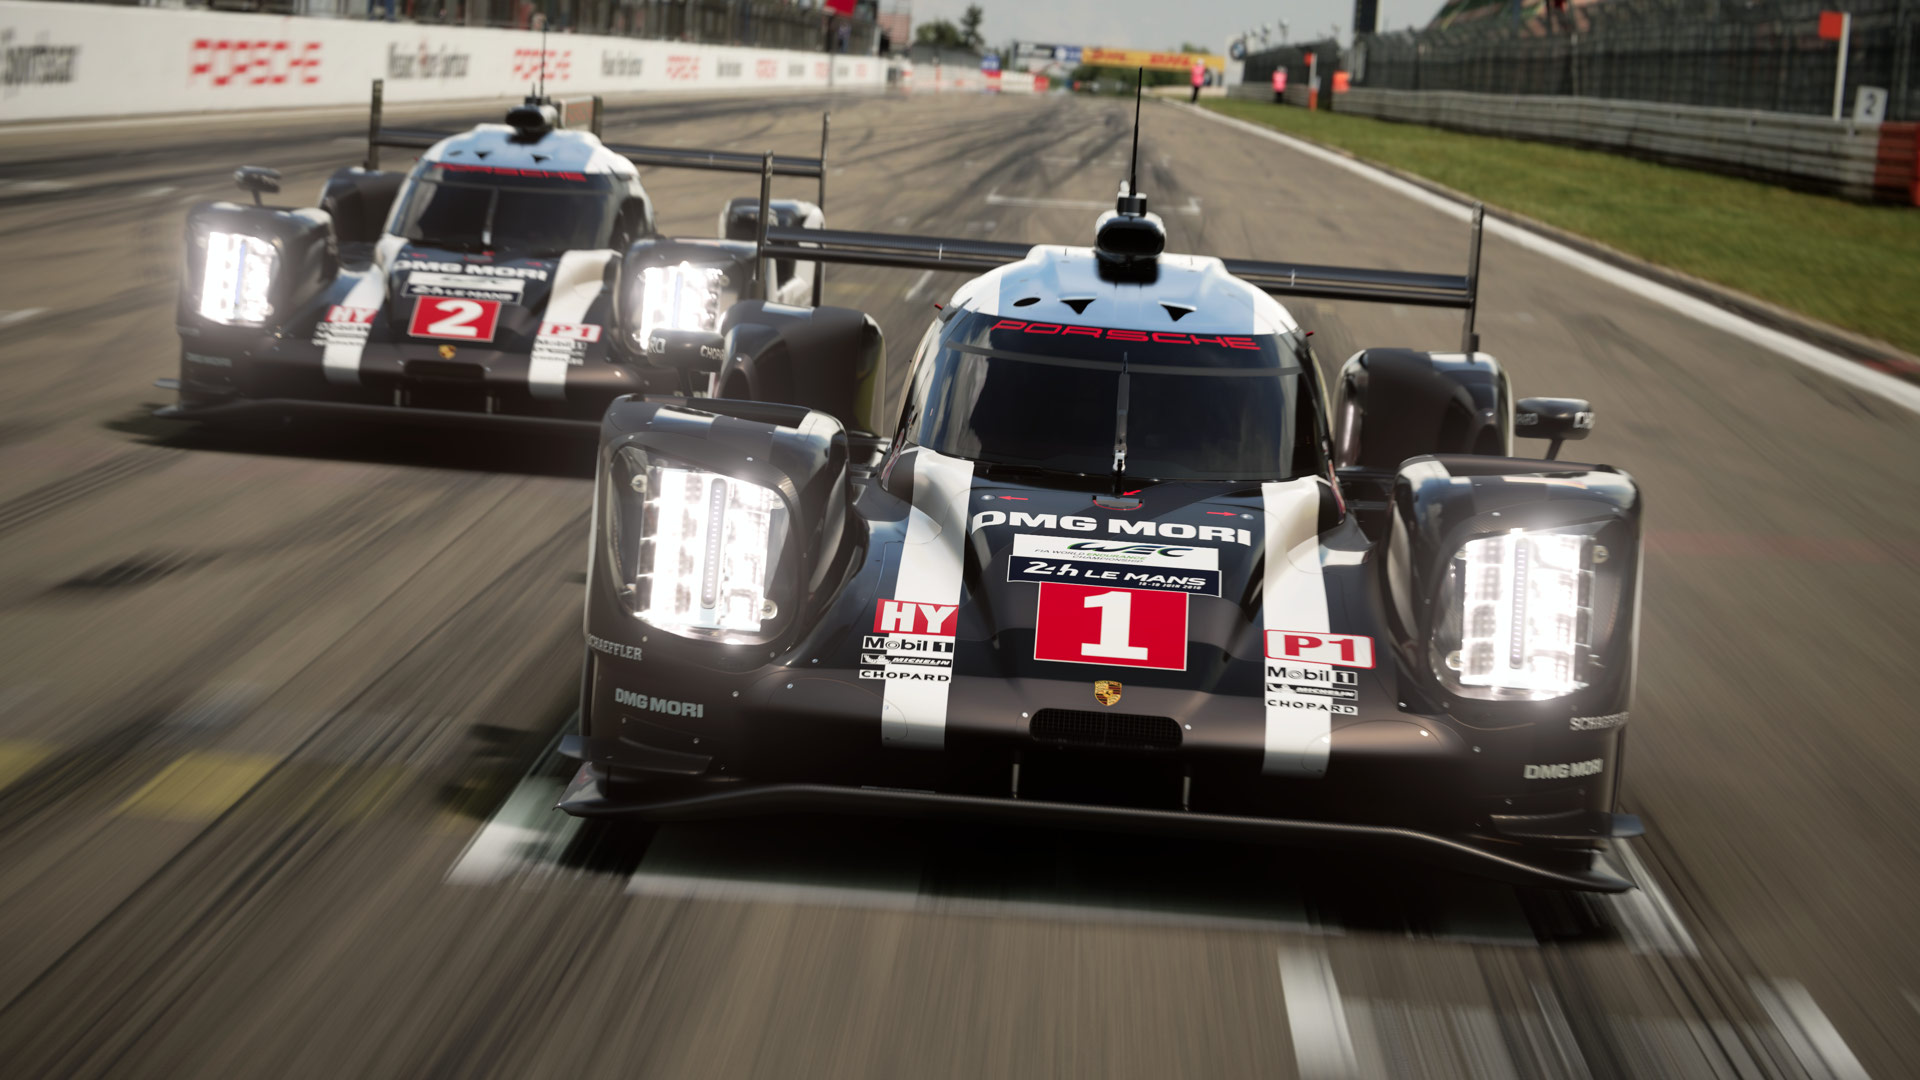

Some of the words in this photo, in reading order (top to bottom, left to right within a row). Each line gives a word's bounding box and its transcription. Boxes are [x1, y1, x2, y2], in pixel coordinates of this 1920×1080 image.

[191, 38, 321, 86] PORSCHE
[1864, 93, 1877, 116] 2
[432, 162, 587, 182] PORSCHE
[393, 260, 463, 274] DMG
[465, 264, 548, 282] MORI
[329, 305, 377, 322] HY
[427, 299, 484, 337] 2
[550, 324, 591, 338] P1
[991, 319, 1261, 350] PORSCHE
[971, 510, 1097, 535] DMG
[1108, 518, 1251, 547] MORI
[1072, 555, 1144, 563] CHAMPIONSHIP
[1086, 552, 1147, 560] ENDURANCE
[1084, 570, 1120, 580] LE
[1123, 572, 1207, 587] MANS
[880, 600, 957, 634] HY
[1080, 591, 1149, 661] 1
[864, 637, 928, 651] Mobil
[1284, 634, 1355, 662] P1
[892, 656, 951, 666] MICHELIN
[861, 670, 950, 682] CHOPARD
[1267, 666, 1330, 682] Mobil
[615, 687, 648, 710] DMG
[650, 697, 704, 718] MORI
[1267, 699, 1355, 713] CHOPARD
[1523, 764, 1569, 779] DMG
